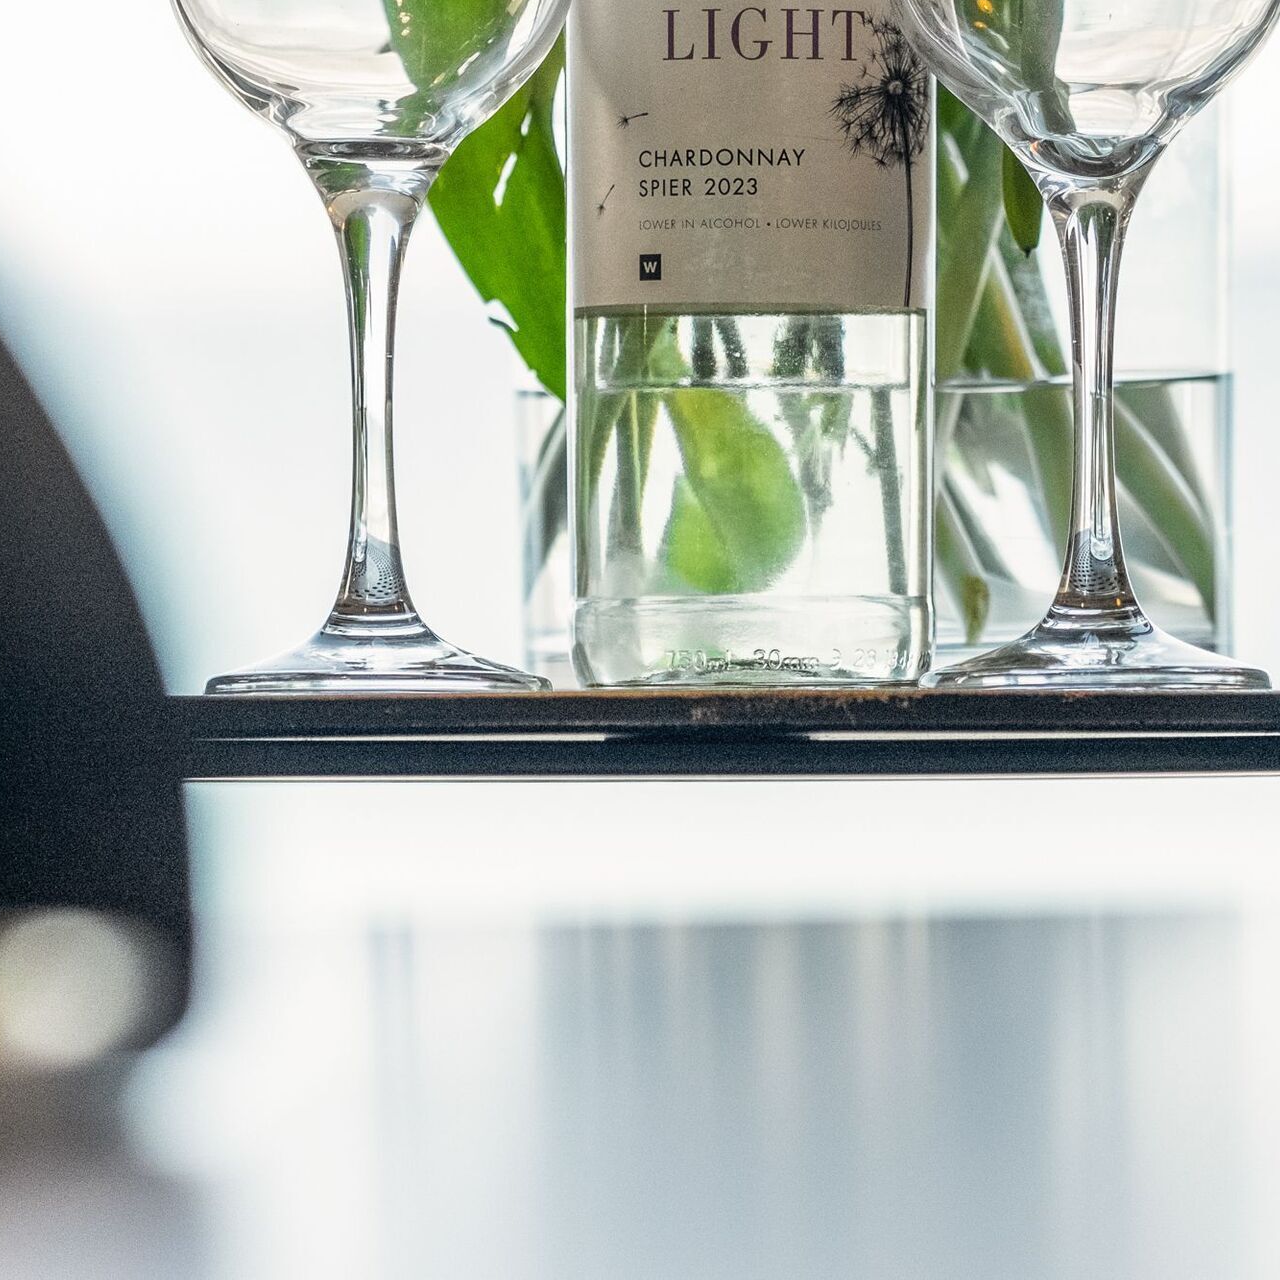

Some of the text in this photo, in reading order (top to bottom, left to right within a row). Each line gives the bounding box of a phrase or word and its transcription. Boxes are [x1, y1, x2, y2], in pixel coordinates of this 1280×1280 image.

[662, 7, 866, 61] LIGHT
[638, 148, 806, 168] CHARDONNAY
[638, 177, 759, 198] SPIER 2023
[638, 217, 882, 232] LOWER IN ALCOHOL LOWER KILOJOULES
